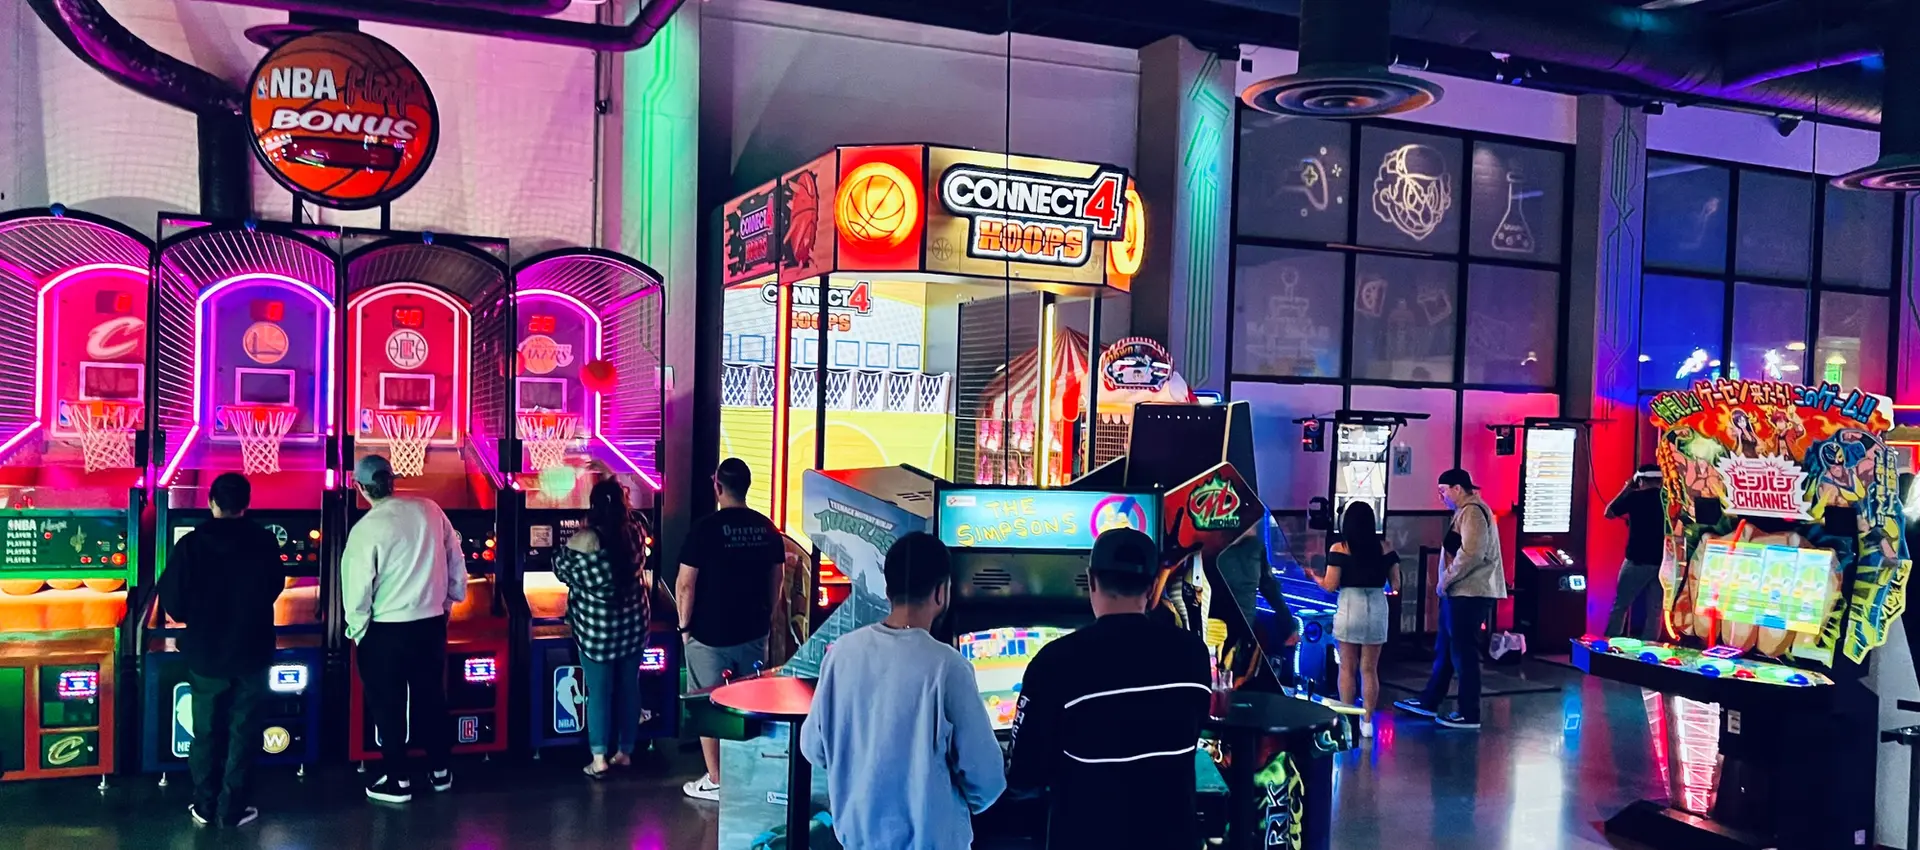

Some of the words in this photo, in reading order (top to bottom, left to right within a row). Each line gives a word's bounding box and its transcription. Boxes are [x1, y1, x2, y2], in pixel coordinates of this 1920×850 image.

[270, 66, 338, 100] NBA
[272, 108, 418, 140] BONUS
[949, 174, 1090, 218] CONNECT
[1083, 177, 1118, 229] 4
[977, 220, 1084, 259] HOOPS
[761, 283, 851, 308] CNNCT
[848, 281, 872, 313] 4
[985, 498, 1037, 519] THE
[1735, 491, 1797, 510] CHANNEL
[956, 511, 1078, 547] SIMPSONS
[557, 719, 575, 729] NBA
